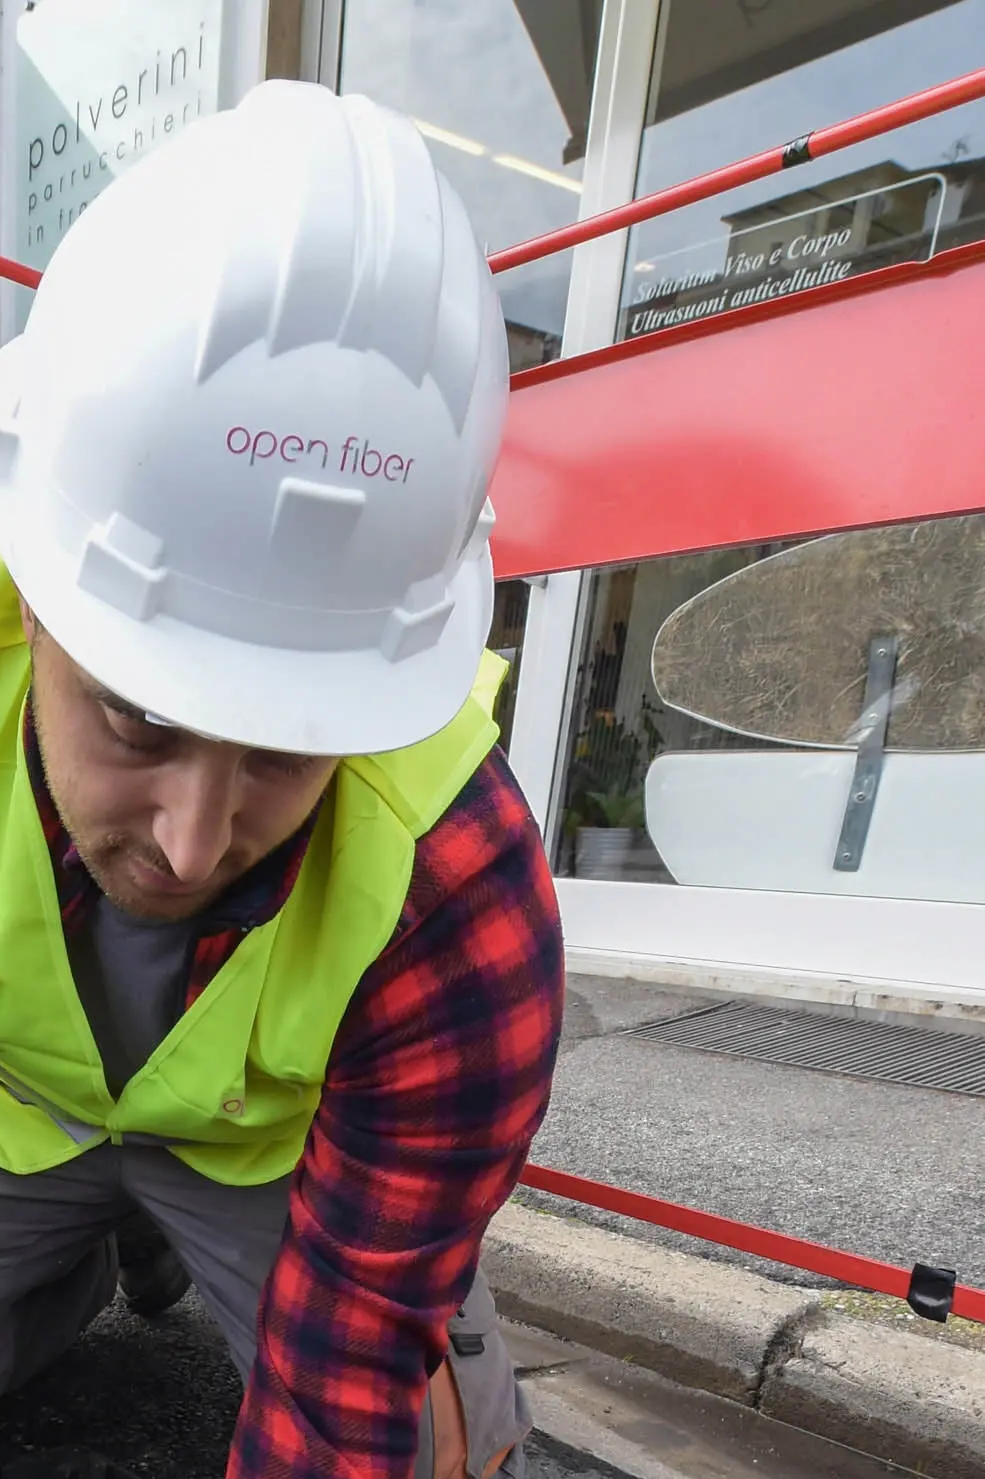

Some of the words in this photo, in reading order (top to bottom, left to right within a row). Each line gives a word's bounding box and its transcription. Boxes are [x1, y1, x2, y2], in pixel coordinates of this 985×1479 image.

[28, 21, 204, 182] polverini
[28, 90, 202, 216] parrucchieri
[28, 225, 44, 248] in
[633, 266, 716, 303] Solarium
[723, 252, 764, 277] Viso
[769, 248, 782, 265] e
[787, 227, 851, 260] Corpo
[631, 289, 729, 334] Ultrasuoni
[730, 260, 852, 308] anticellulite
[226, 426, 329, 469] open
[339, 436, 415, 484] fiber
